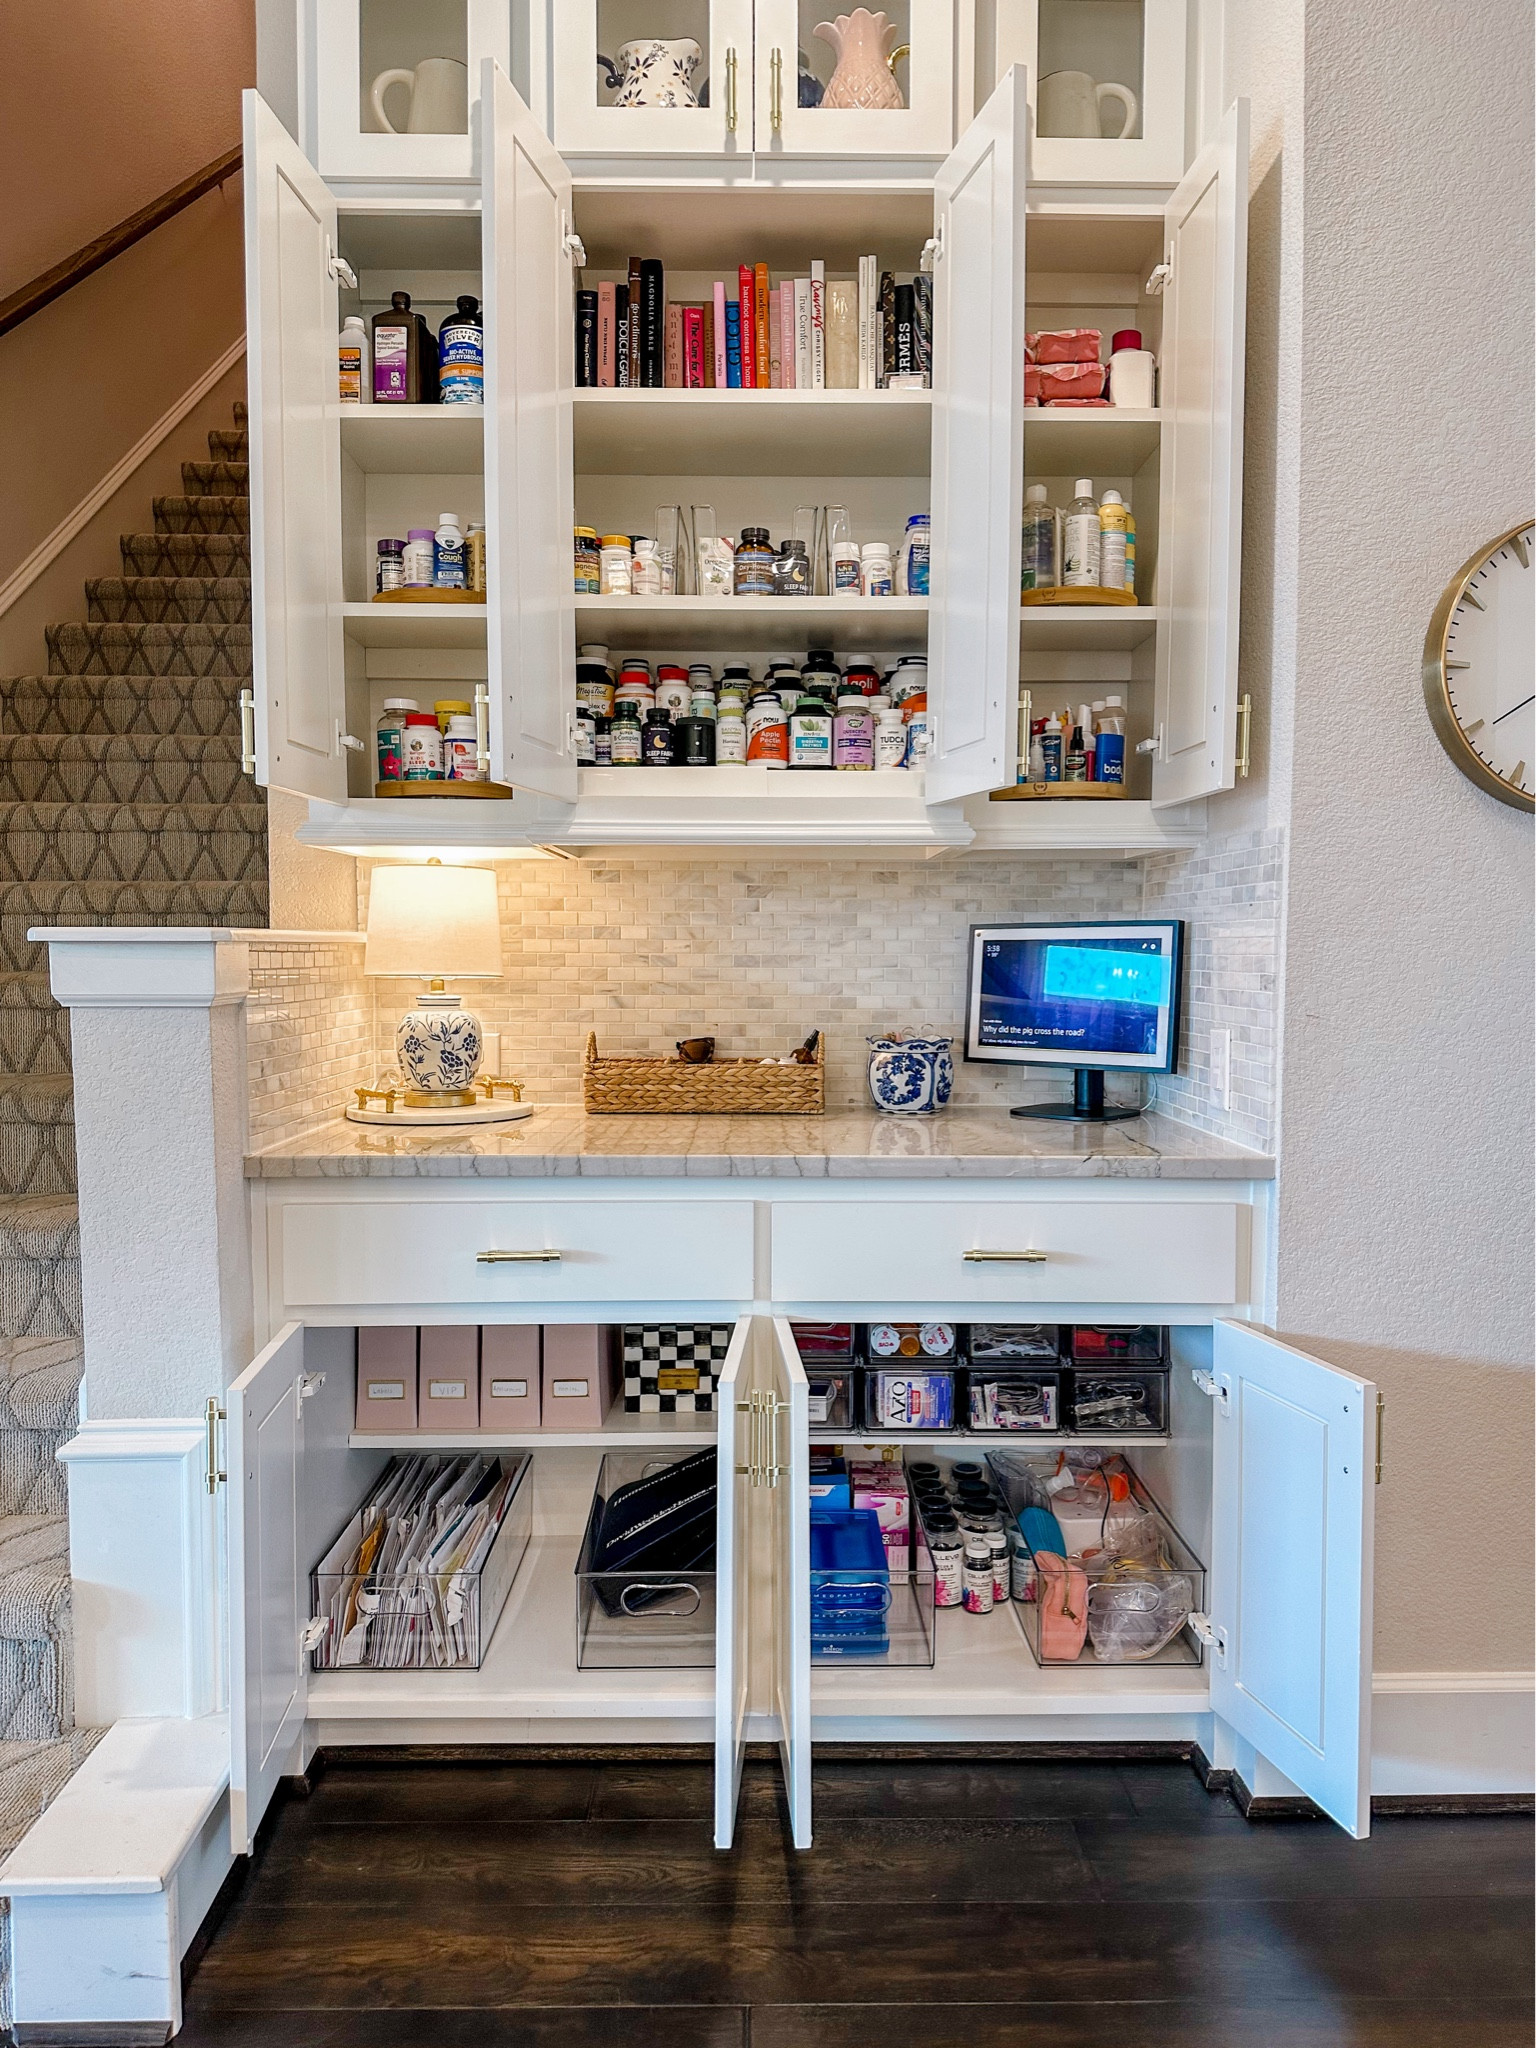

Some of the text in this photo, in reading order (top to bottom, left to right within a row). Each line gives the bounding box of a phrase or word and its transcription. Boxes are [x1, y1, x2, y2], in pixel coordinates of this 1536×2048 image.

[810, 280, 824, 334] Cravings
[448, 335, 480, 343] SILVER
[619, 320, 628, 354] DOLCE
[728, 305, 741, 365] GUCCI
[783, 314, 792, 336] good
[800, 315, 808, 350] Comfort
[632, 326, 640, 359] dinners
[744, 356, 750, 364] at
[438, 552, 462, 562] Cough
[983, 1026, 996, 1034] Why
[1022, 1027, 1033, 1036] pig
[890, 1381, 906, 1422] AZO
[614, 1471, 679, 1507] Homeowner
